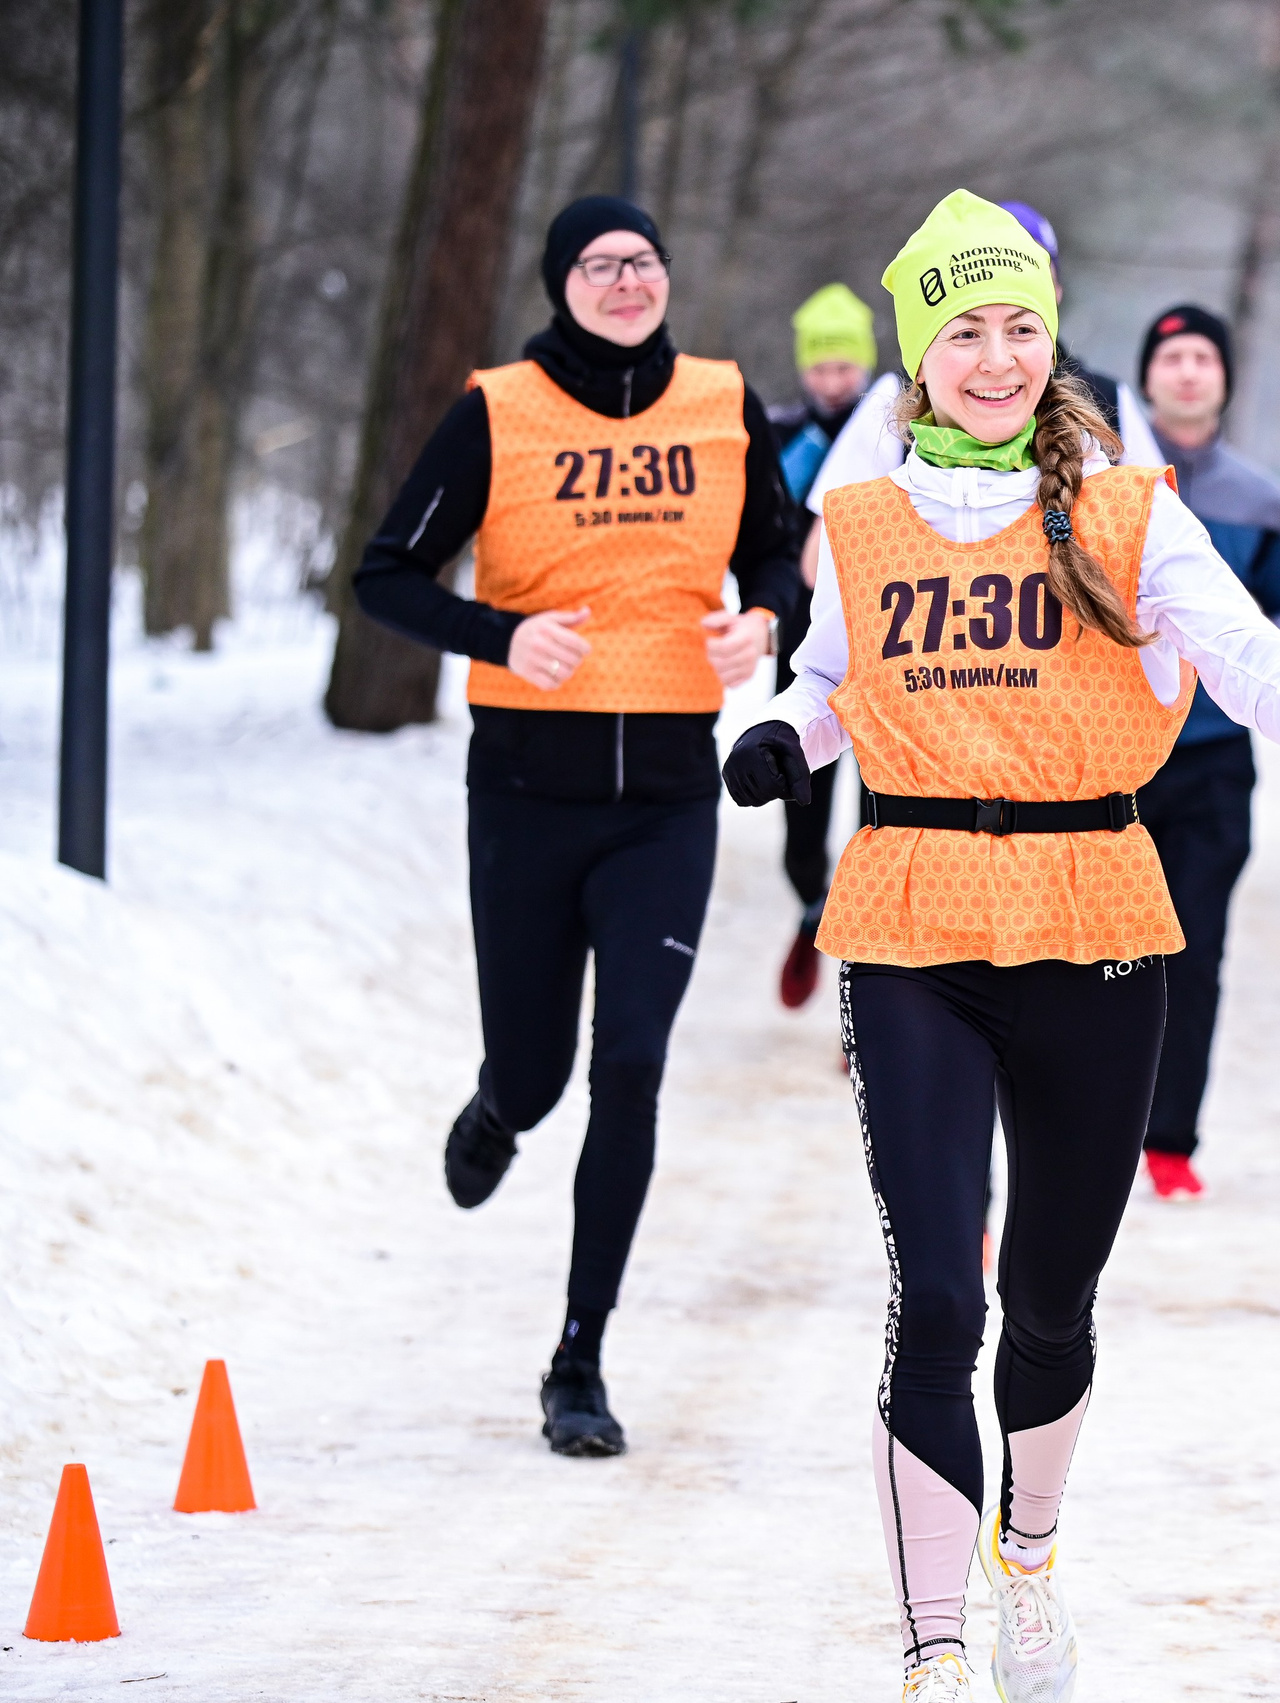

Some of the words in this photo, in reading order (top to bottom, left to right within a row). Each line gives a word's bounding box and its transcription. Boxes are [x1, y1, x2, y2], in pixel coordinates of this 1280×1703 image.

[949, 246, 1040, 270] Anonymous
[950, 258, 1024, 277] Running
[952, 269, 994, 289] Club
[555, 444, 696, 501] 27:30
[880, 572, 1063, 660] 27:30
[904, 666, 947, 693] 5:30
